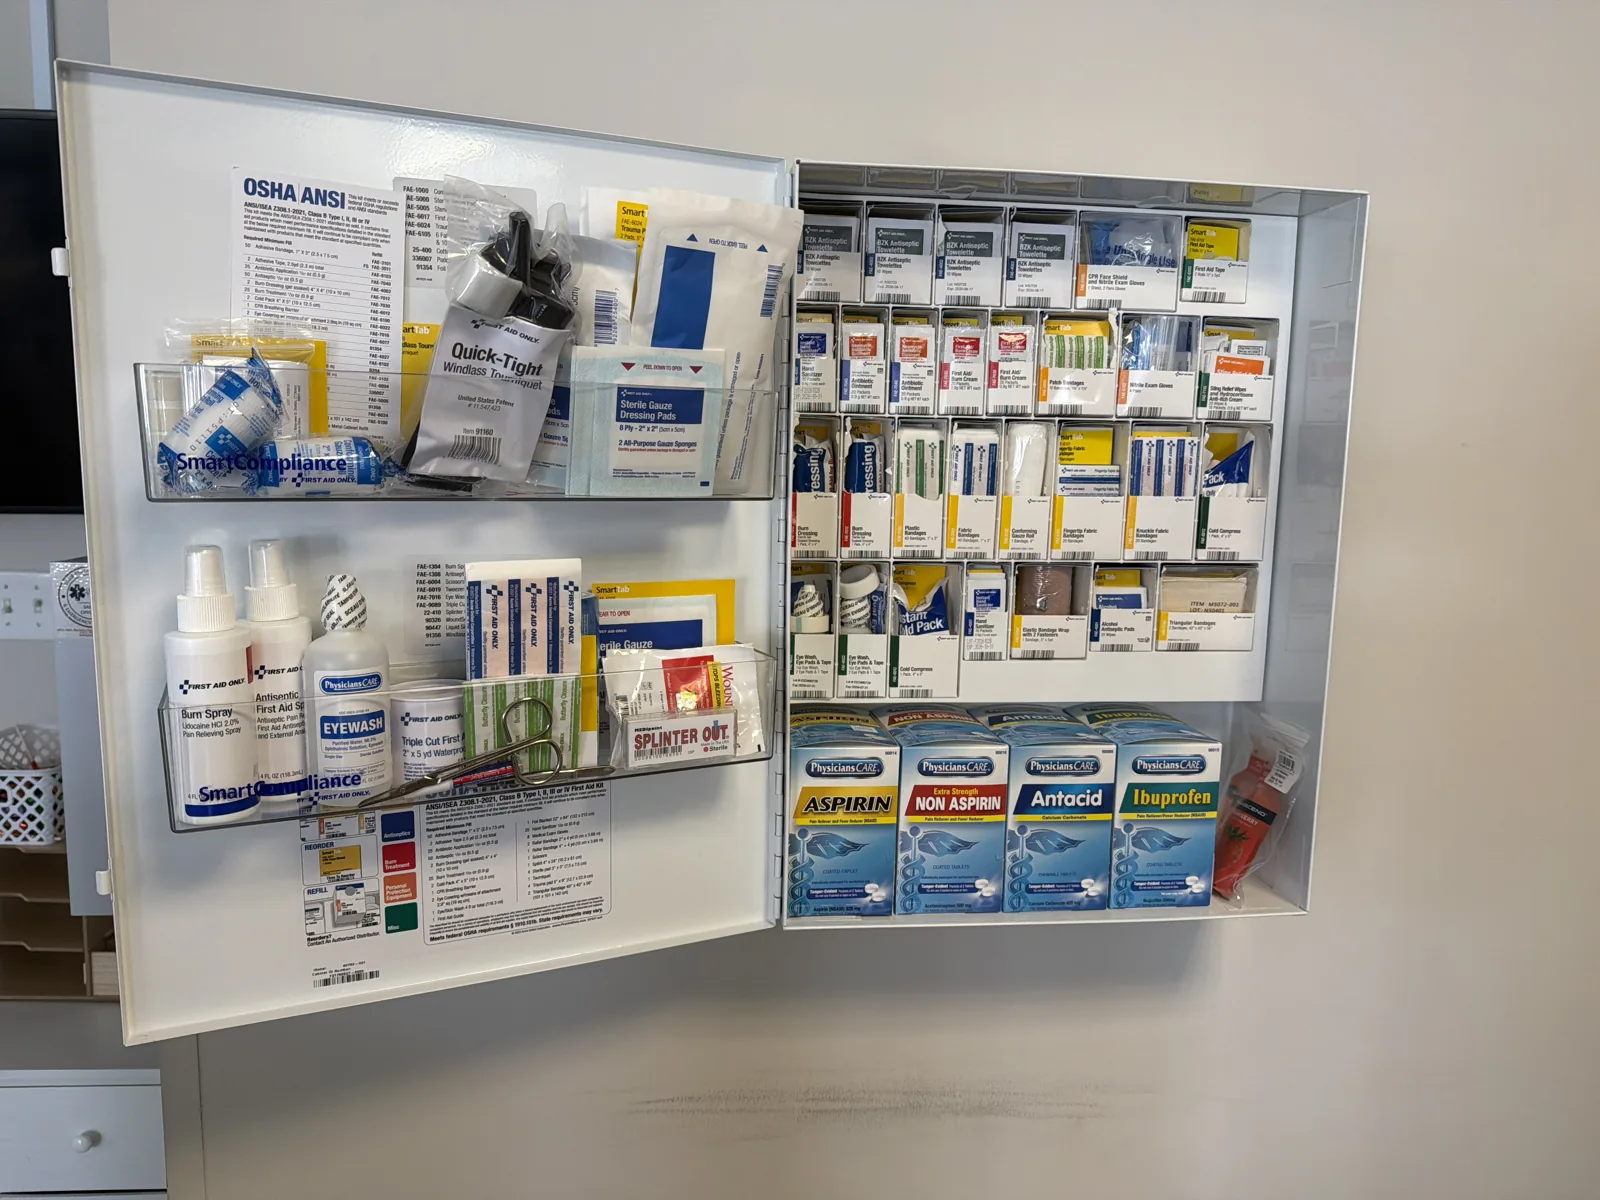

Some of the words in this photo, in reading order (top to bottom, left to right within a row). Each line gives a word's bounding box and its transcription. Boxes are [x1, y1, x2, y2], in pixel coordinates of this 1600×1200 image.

[244, 177, 297, 202] OSHA
[301, 187, 345, 209] ANSI
[403, 186, 429, 194] FAE-1000
[244, 202, 272, 211] ANSI/ISEA
[273, 206, 306, 216] Z308.1-2021,
[308, 210, 322, 218] Class
[622, 206, 644, 218] Smart
[621, 225, 640, 233] Trauma
[452, 342, 543, 377] Quick-Tight
[443, 361, 487, 376] Windlass
[458, 394, 476, 403] United
[477, 396, 494, 404] States
[496, 399, 514, 408] Patent
[620, 399, 647, 410] Sterile
[649, 400, 673, 410] Gauze
[620, 410, 656, 421] Dressing
[658, 412, 676, 421] Pads
[475, 428, 493, 436] 91160
[177, 452, 347, 475] SmartCompliance
[918, 618, 943, 632] Pack
[213, 681, 227, 689] AID
[182, 709, 202, 719] Burn
[205, 708, 233, 720] Spray
[256, 705, 276, 714] First
[279, 702, 293, 712] Aid
[324, 717, 382, 735] EYEWASH
[183, 730, 194, 738] Pain
[196, 729, 224, 737] Relieving
[225, 727, 241, 735] Spray
[634, 727, 698, 750] SPLINTER
[702, 724, 728, 742] OUT
[402, 736, 423, 747] Triple
[425, 737, 440, 746] Cut
[443, 735, 460, 744] First
[952, 788, 979, 796] Strength
[425, 803, 458, 812] ANSI/ISEA
[459, 797, 497, 806] Z308.1-2021,
[803, 795, 893, 814] ASPIRIN
[915, 797, 946, 811] NON
[949, 796, 1001, 811] ASPIRIN
[1030, 790, 1103, 807] Antacid
[1133, 788, 1211, 809] Ibuprofen
[384, 831, 411, 839] Antiseptics
[305, 842, 334, 851] REORDER
[307, 887, 328, 895] REFILL
[307, 939, 324, 947] Contact
